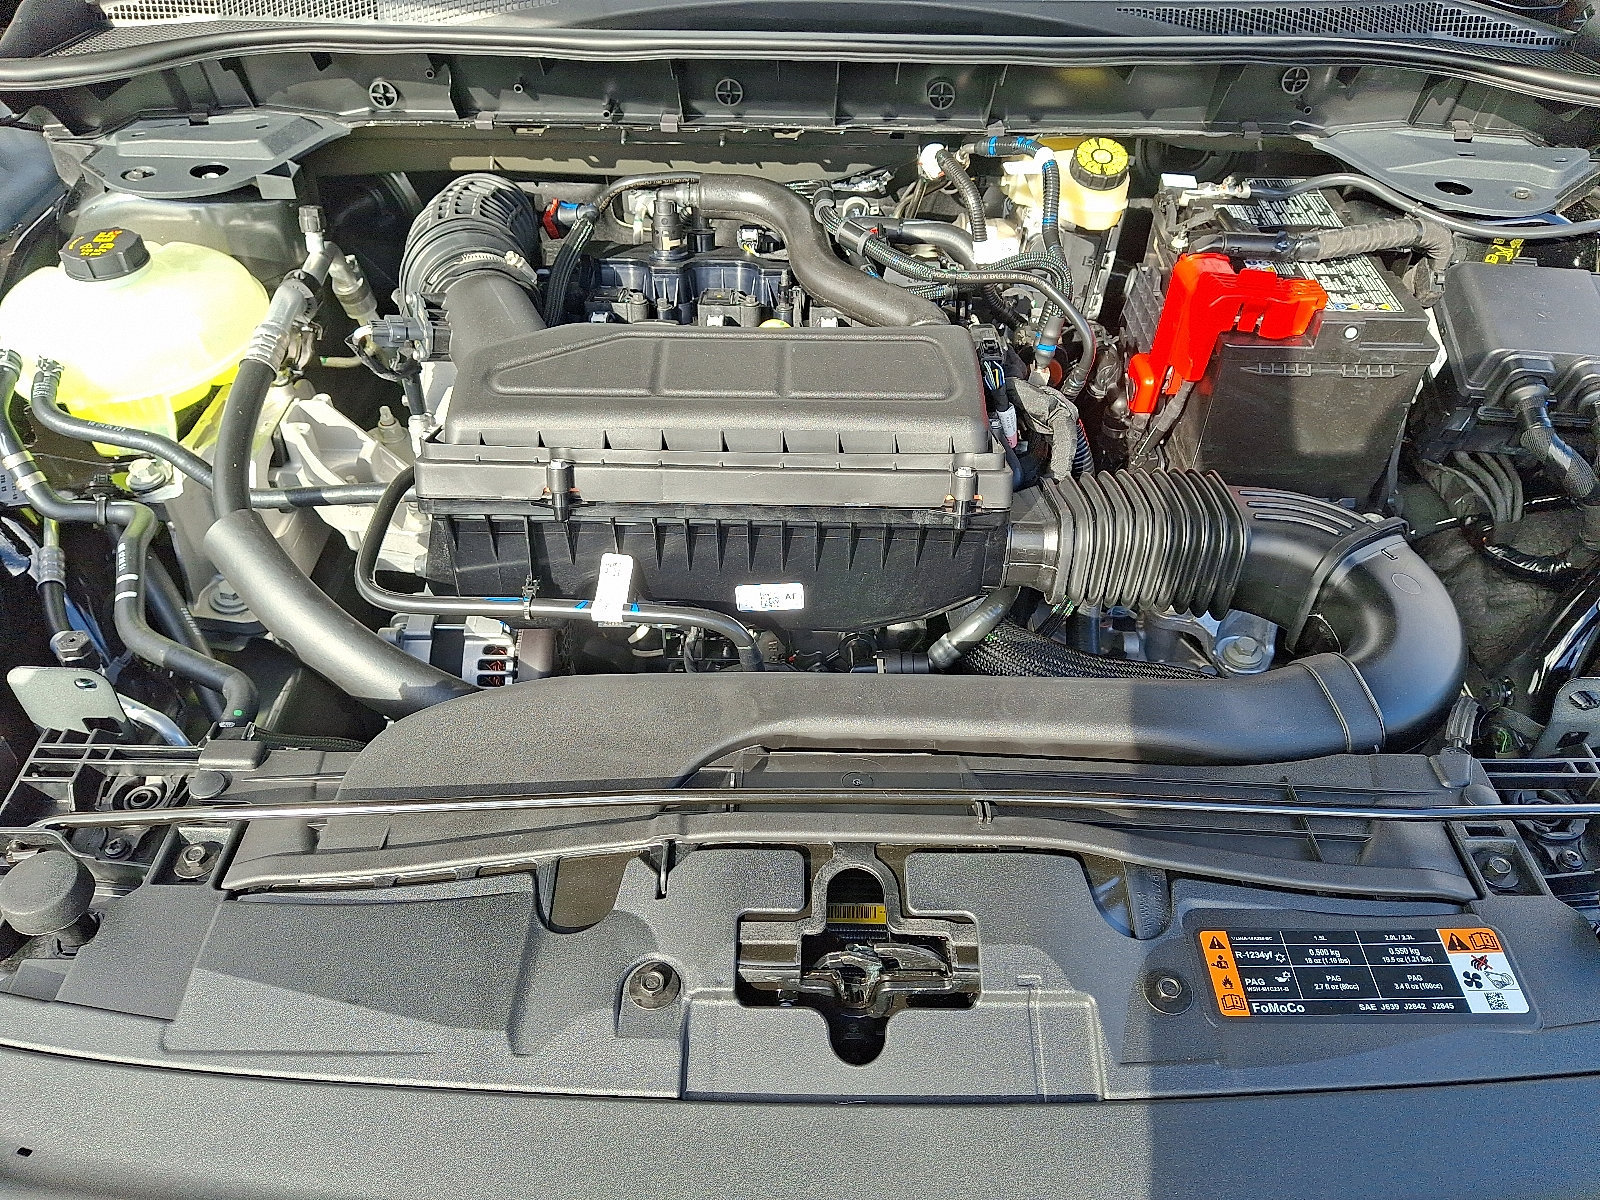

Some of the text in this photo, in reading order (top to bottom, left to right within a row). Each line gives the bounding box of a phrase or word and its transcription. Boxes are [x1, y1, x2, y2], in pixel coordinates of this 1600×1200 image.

[1234, 950, 1273, 961] R-1234yf
[1330, 948, 1341, 958] kg
[1388, 946, 1421, 956] 0.550 kg
[1244, 977, 1266, 986] PAG
[1325, 974, 1342, 982] PAG
[1406, 974, 1423, 982] PAG
[1251, 1002, 1306, 1013] FoMoCo
[1358, 1003, 1378, 1011] SAE
